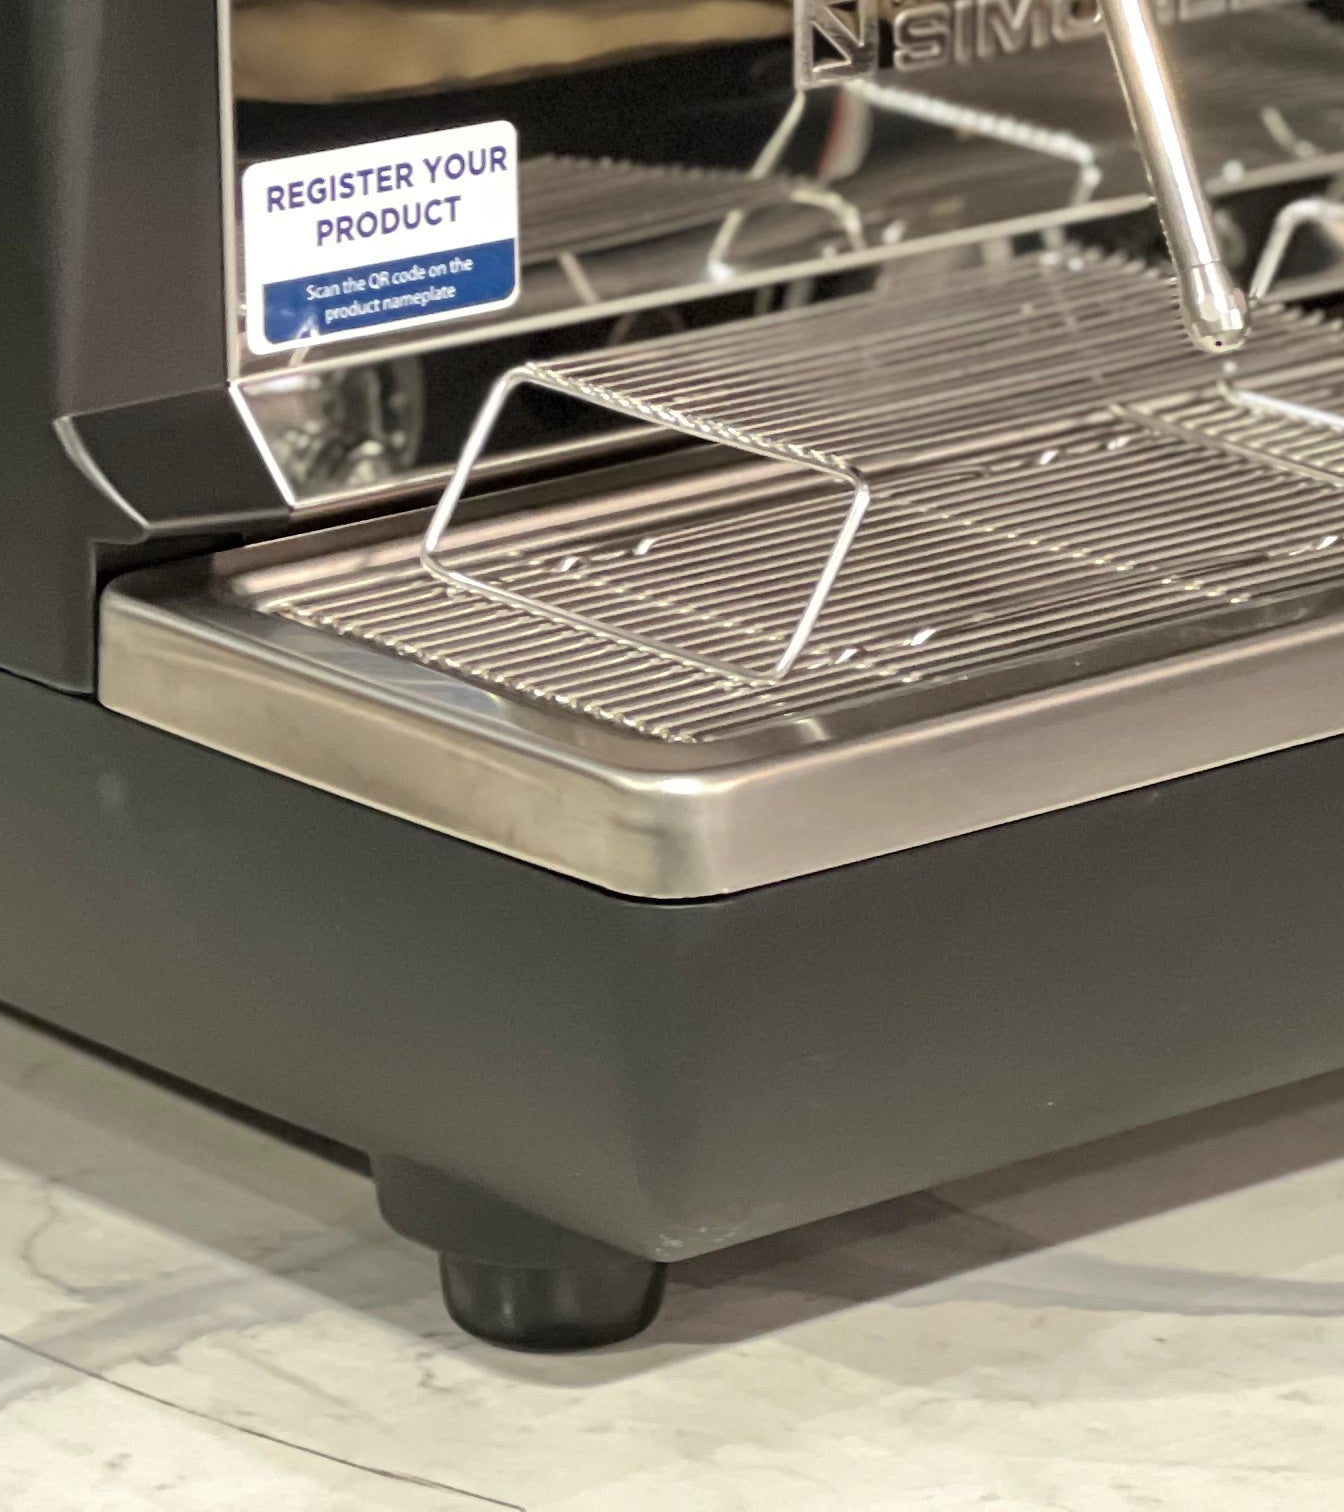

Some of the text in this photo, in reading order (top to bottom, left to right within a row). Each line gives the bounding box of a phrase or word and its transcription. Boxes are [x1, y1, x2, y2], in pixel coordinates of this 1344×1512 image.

[266, 145, 508, 212] REGISTER YOUR
[316, 195, 461, 246] PRODUCT
[306, 257, 474, 301] Scan the QR code on the
[325, 284, 457, 325] product nameplate
